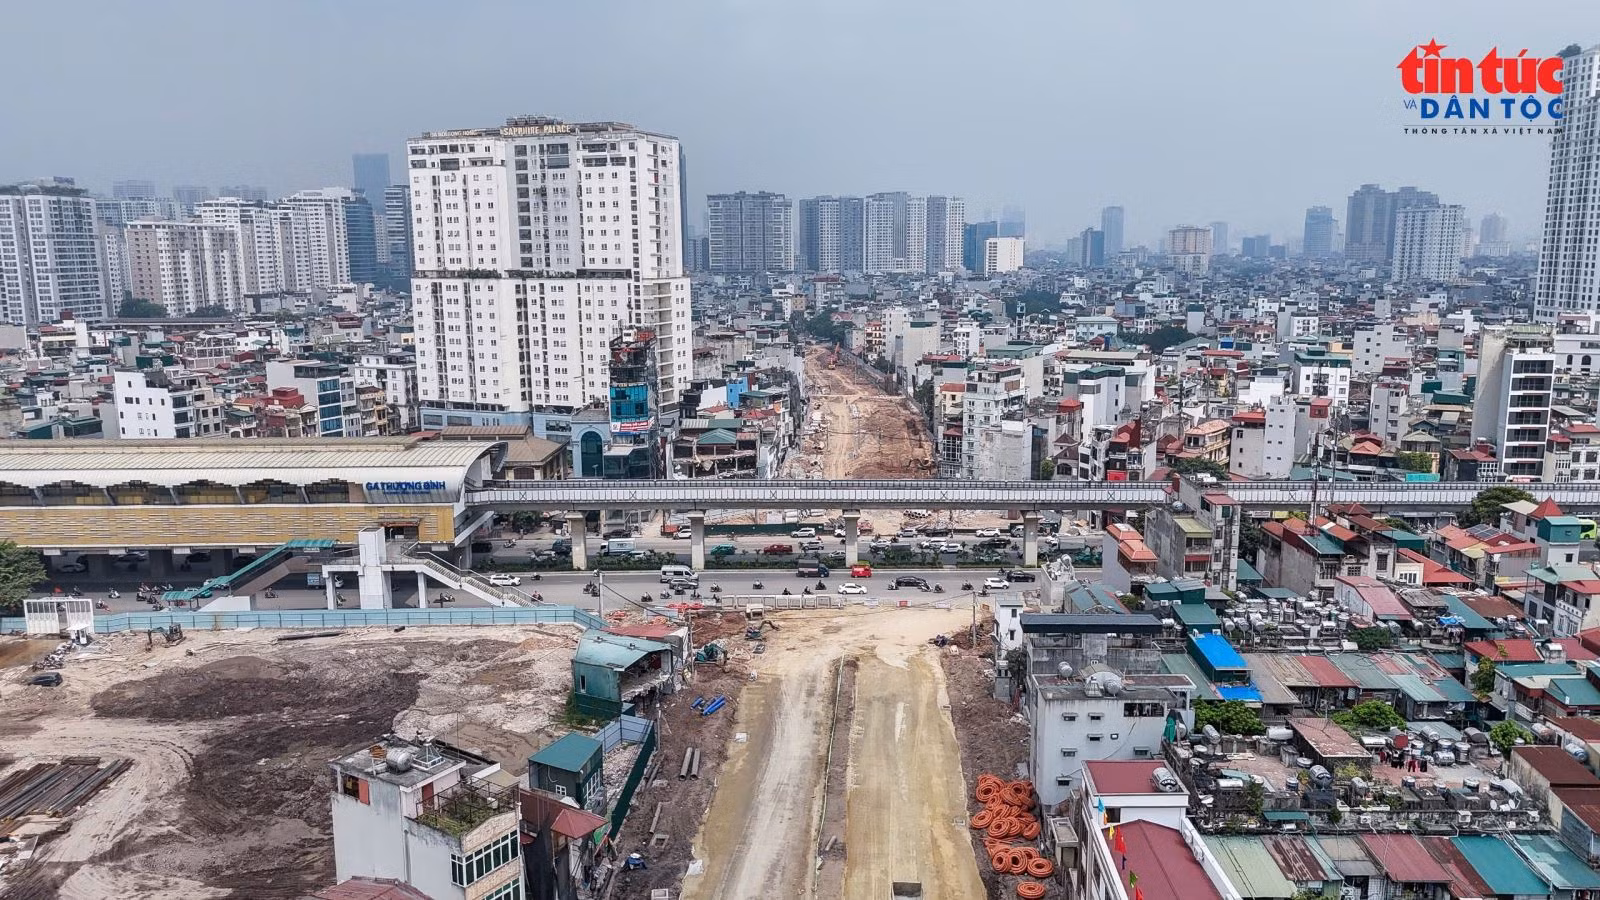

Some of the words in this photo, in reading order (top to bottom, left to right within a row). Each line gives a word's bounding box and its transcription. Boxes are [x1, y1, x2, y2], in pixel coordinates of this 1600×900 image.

[503, 126, 539, 136] SAPPHIRE
[543, 124, 571, 134] PALACE
[366, 481, 380, 491] GA
